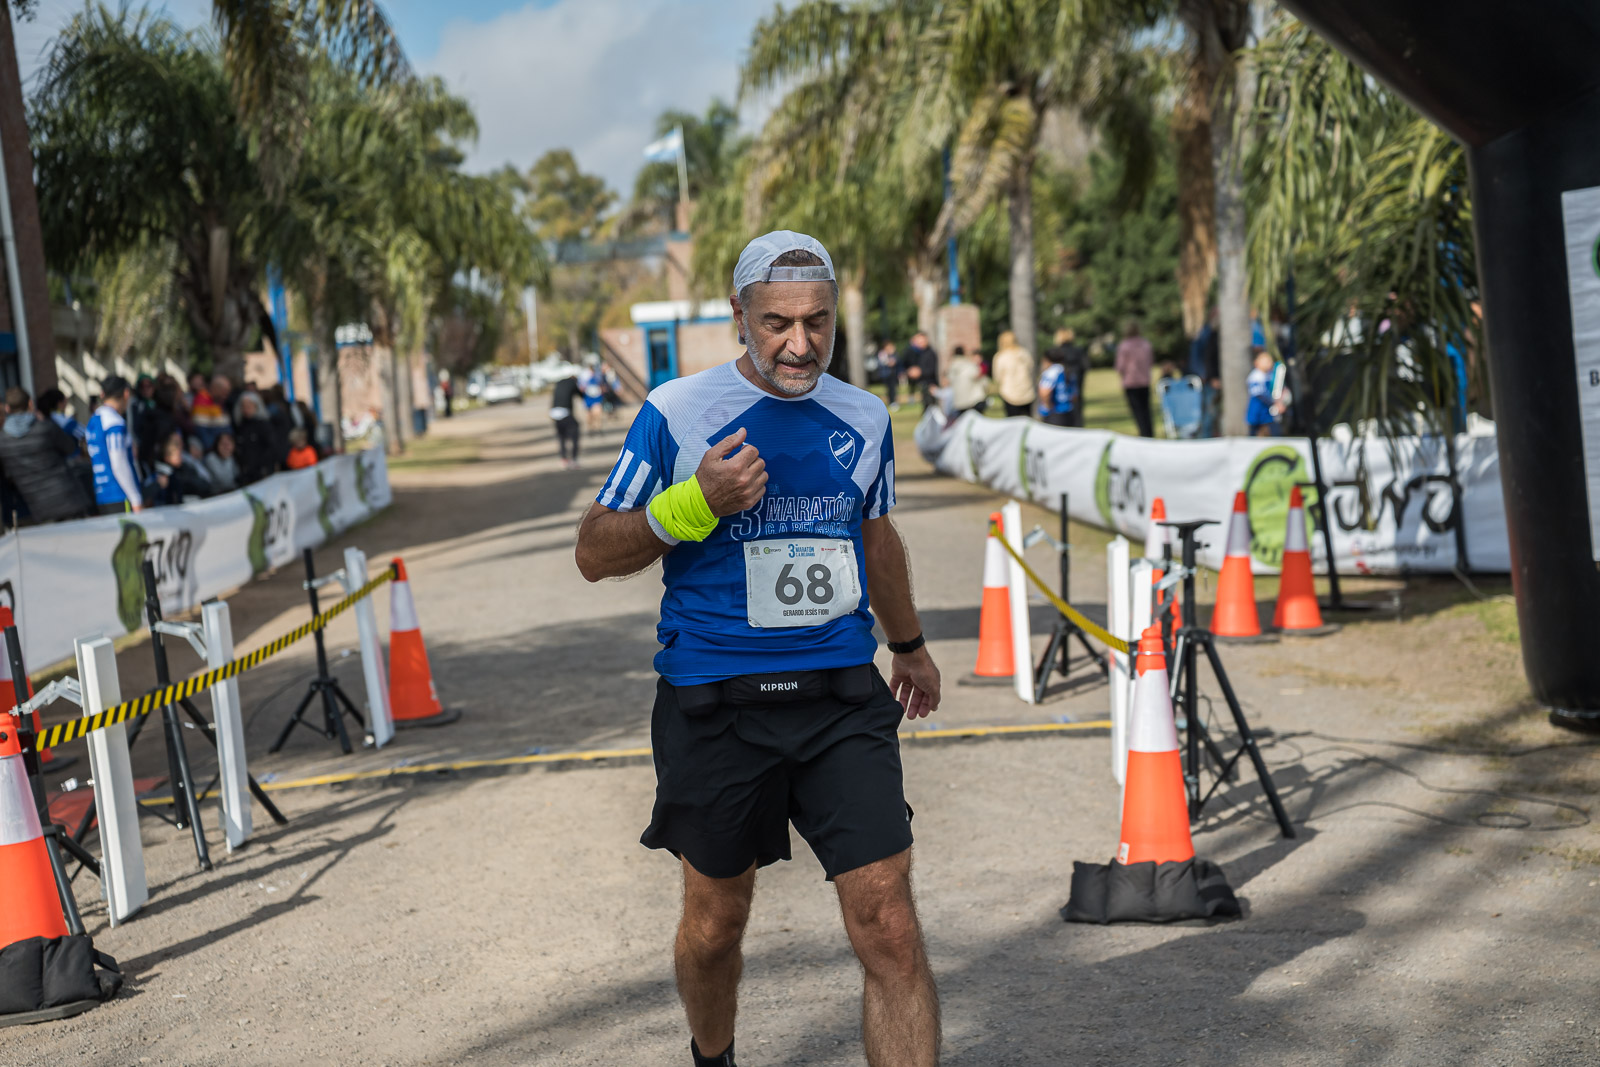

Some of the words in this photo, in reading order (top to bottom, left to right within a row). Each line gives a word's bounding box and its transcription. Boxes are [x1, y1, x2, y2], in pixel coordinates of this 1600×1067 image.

[766, 492, 855, 521] MARATÓN
[775, 564, 834, 605] 68
[804, 607, 817, 616] JESÚS
[760, 681, 798, 691] KIPRUN
